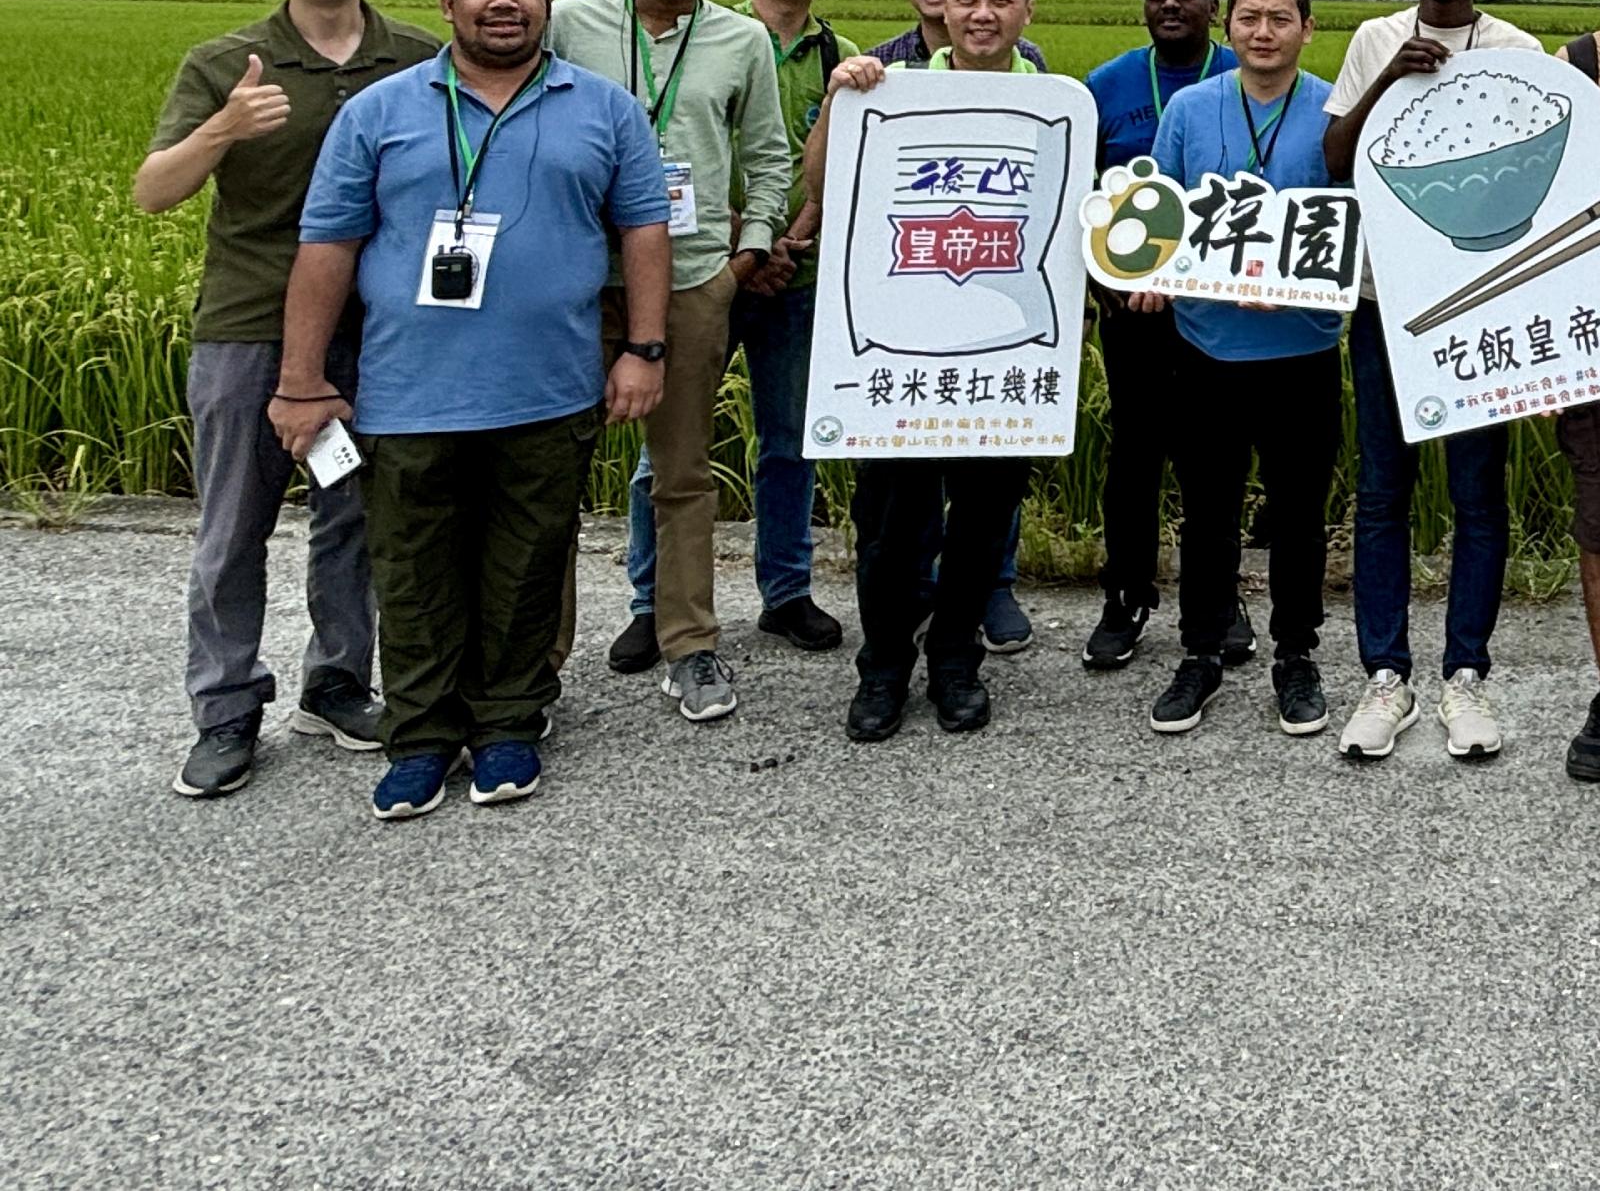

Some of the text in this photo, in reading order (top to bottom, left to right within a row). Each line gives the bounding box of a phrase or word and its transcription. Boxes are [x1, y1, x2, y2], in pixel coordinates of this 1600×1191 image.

[907, 226, 1011, 266] 皇帝米
[1188, 178, 1362, 291] 梓園
[834, 365, 1062, 407] 一袋米要扛幾樓
